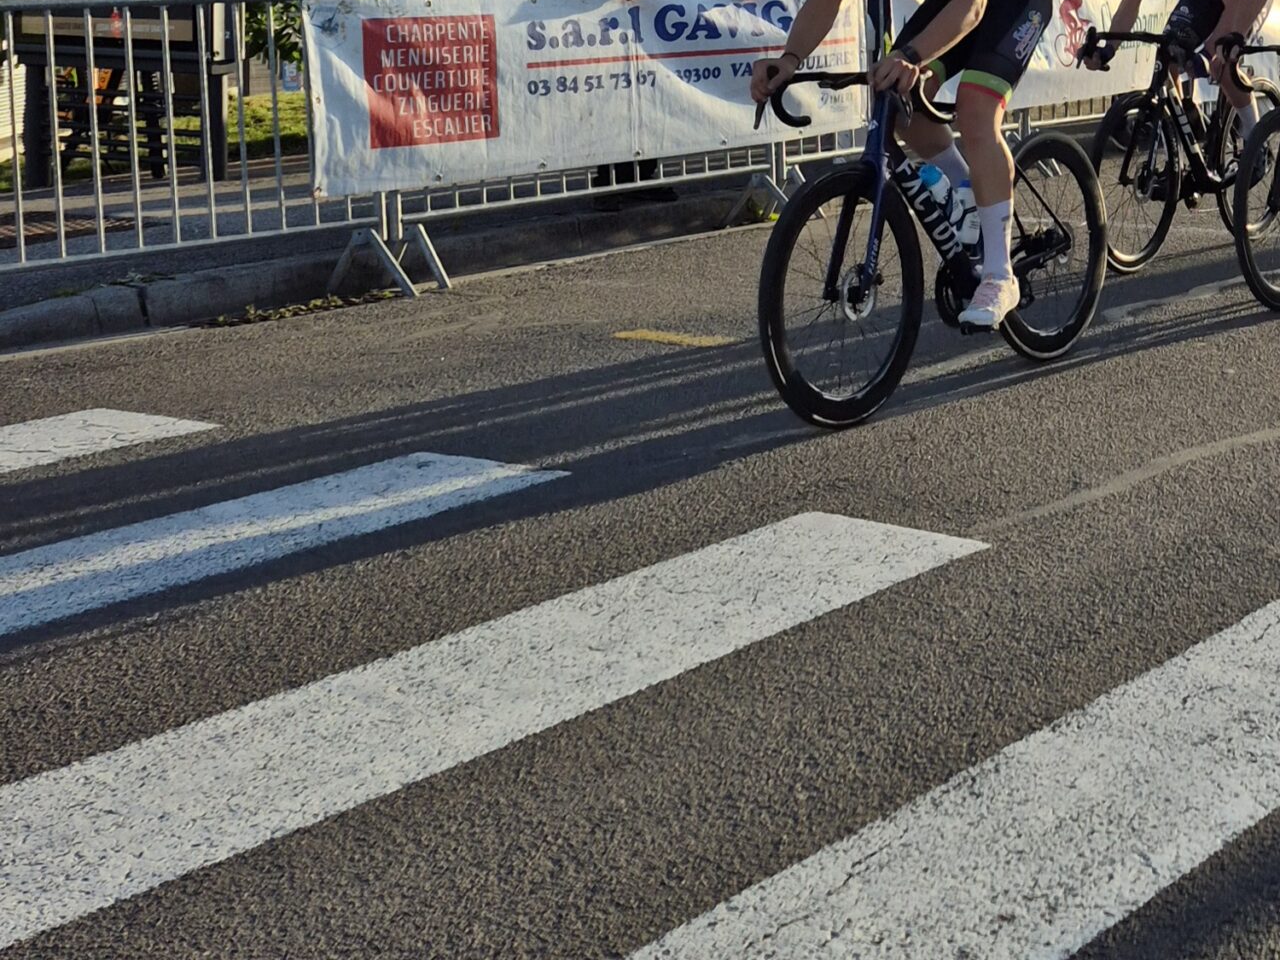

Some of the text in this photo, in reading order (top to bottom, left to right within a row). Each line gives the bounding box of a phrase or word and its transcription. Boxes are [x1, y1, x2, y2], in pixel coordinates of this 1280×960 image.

[386, 20, 490, 44] CHARPENTE
[380, 44, 490, 69] MENUISERIE
[373, 67, 490, 93] COUVERTURE
[527, 79, 550, 97] 03
[555, 75, 579, 94] 84
[583, 74, 606, 93] 51
[609, 72, 632, 90] 73
[636, 69, 657, 88] 67
[398, 90, 491, 116] ZINGUERIE
[412, 114, 492, 139] ESCALIER
[894, 158, 963, 260] FACTOR
